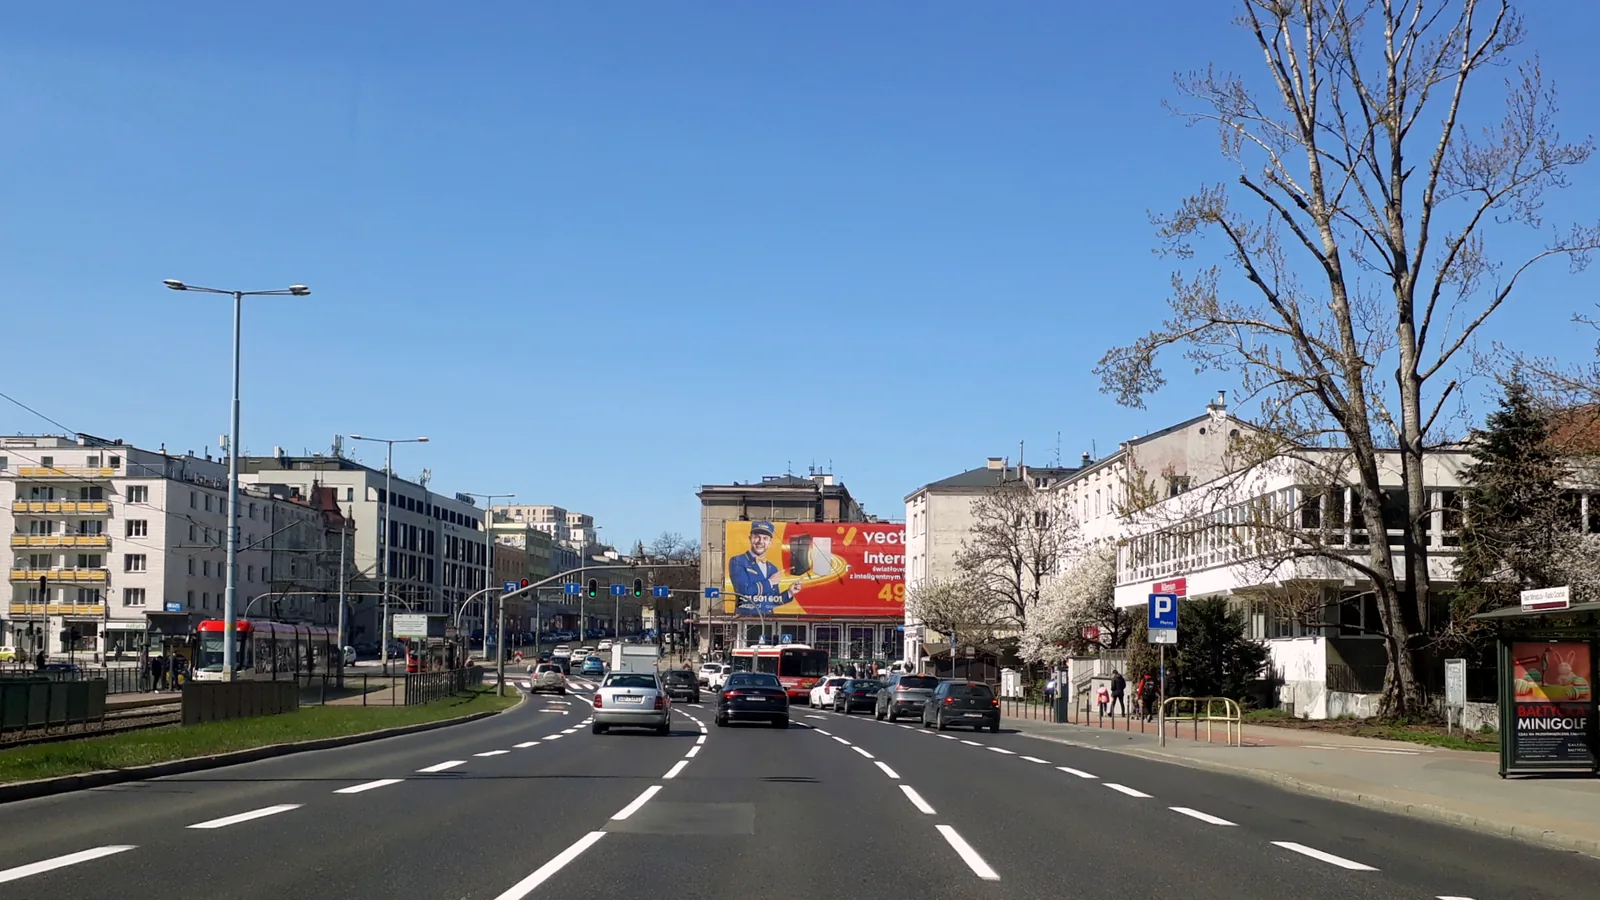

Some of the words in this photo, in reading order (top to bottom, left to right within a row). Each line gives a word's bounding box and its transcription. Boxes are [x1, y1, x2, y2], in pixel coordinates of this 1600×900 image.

[878, 583, 905, 602] 49
[1155, 596, 1172, 619] P
[1517, 717, 1587, 730] MINIGOLF
